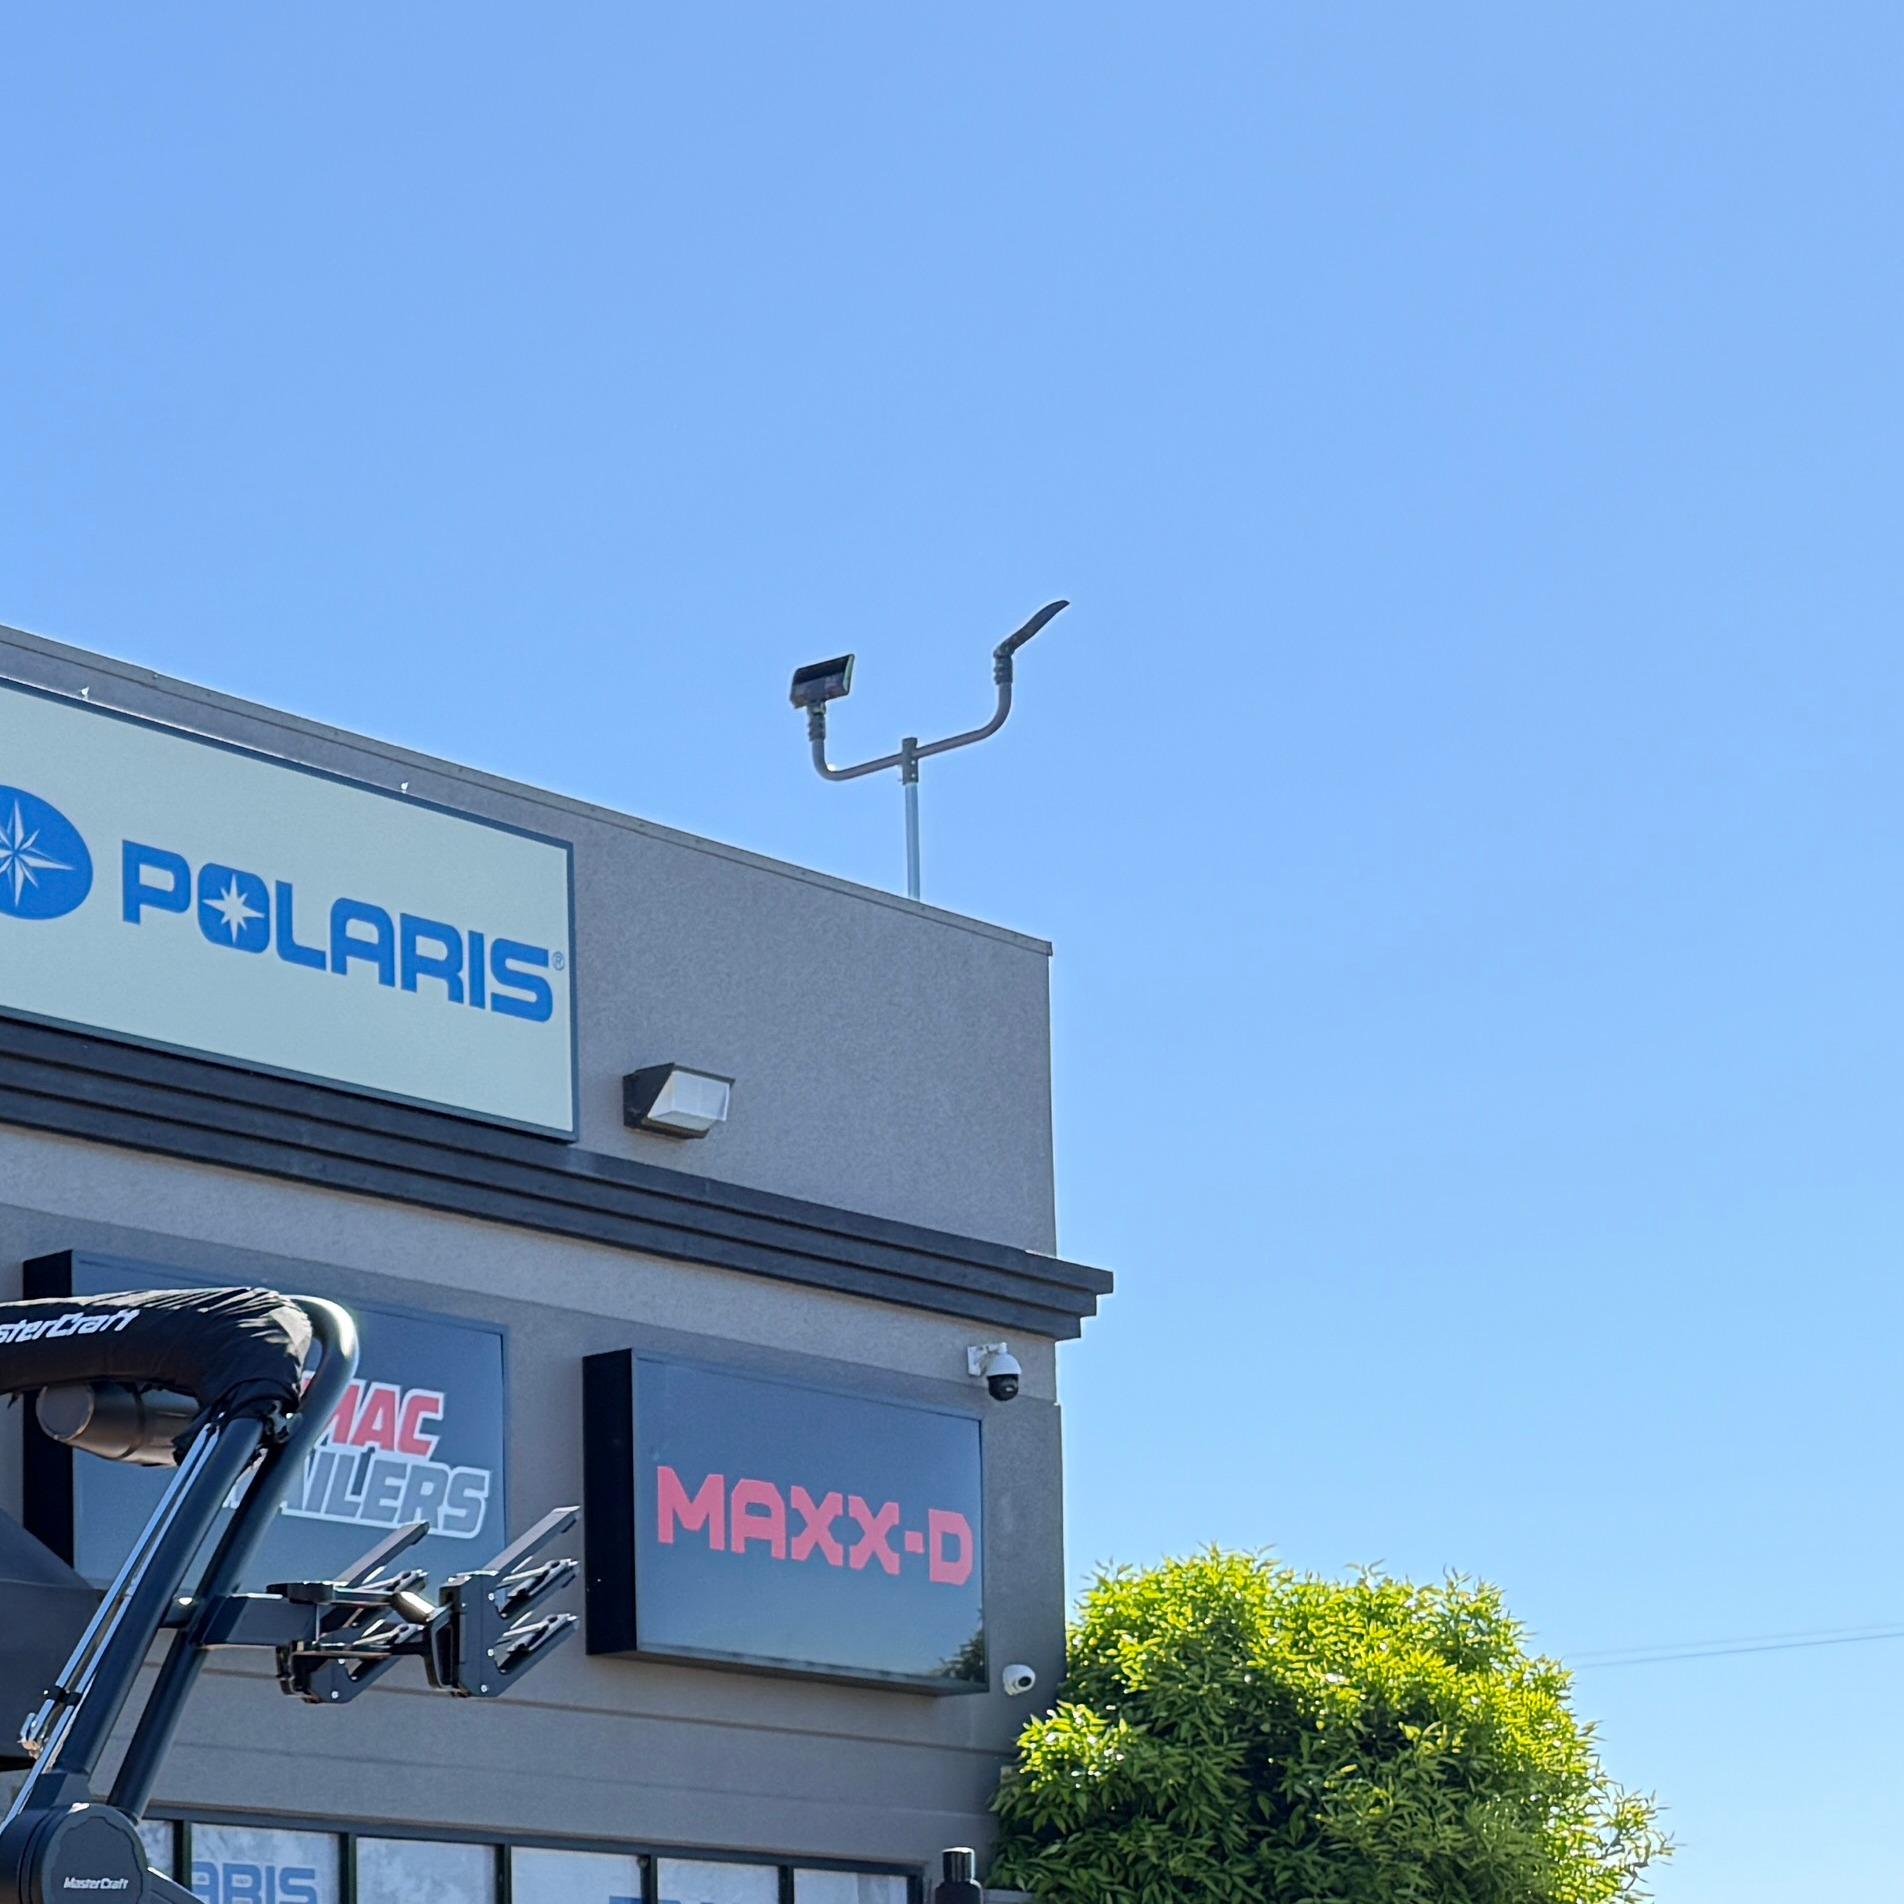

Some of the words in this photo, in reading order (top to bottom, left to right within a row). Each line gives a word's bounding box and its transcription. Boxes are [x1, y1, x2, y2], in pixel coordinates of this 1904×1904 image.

[121, 838, 553, 1023] POLARIS
[656, 1465, 975, 1586] MAXX-D
[63, 1877, 129, 1891] MasterCraft
